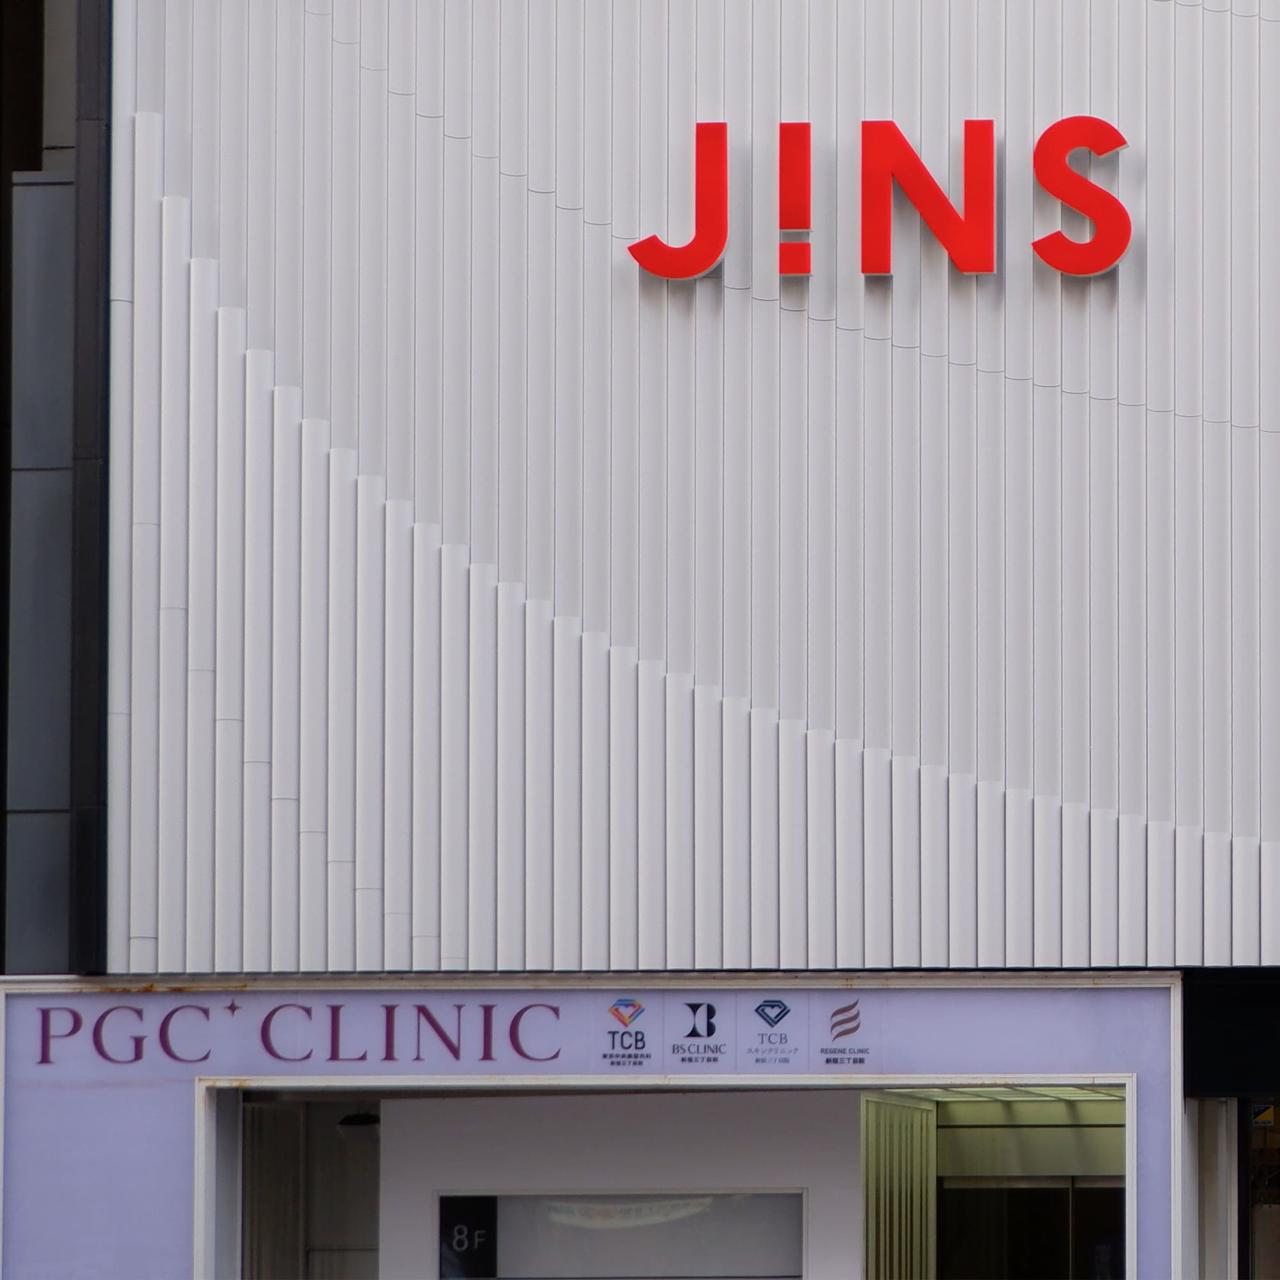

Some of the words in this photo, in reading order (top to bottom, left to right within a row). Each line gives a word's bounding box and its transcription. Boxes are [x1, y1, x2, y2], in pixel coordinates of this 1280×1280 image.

[36, 1004, 213, 1065] PGC
[260, 1003, 562, 1062] CLINIC
[607, 1030, 646, 1050] TCB
[758, 1033, 788, 1045] TCB
[672, 1043, 686, 1055] BS
[687, 1043, 728, 1055] CLINIC
[452, 1224, 487, 1252] 8F
